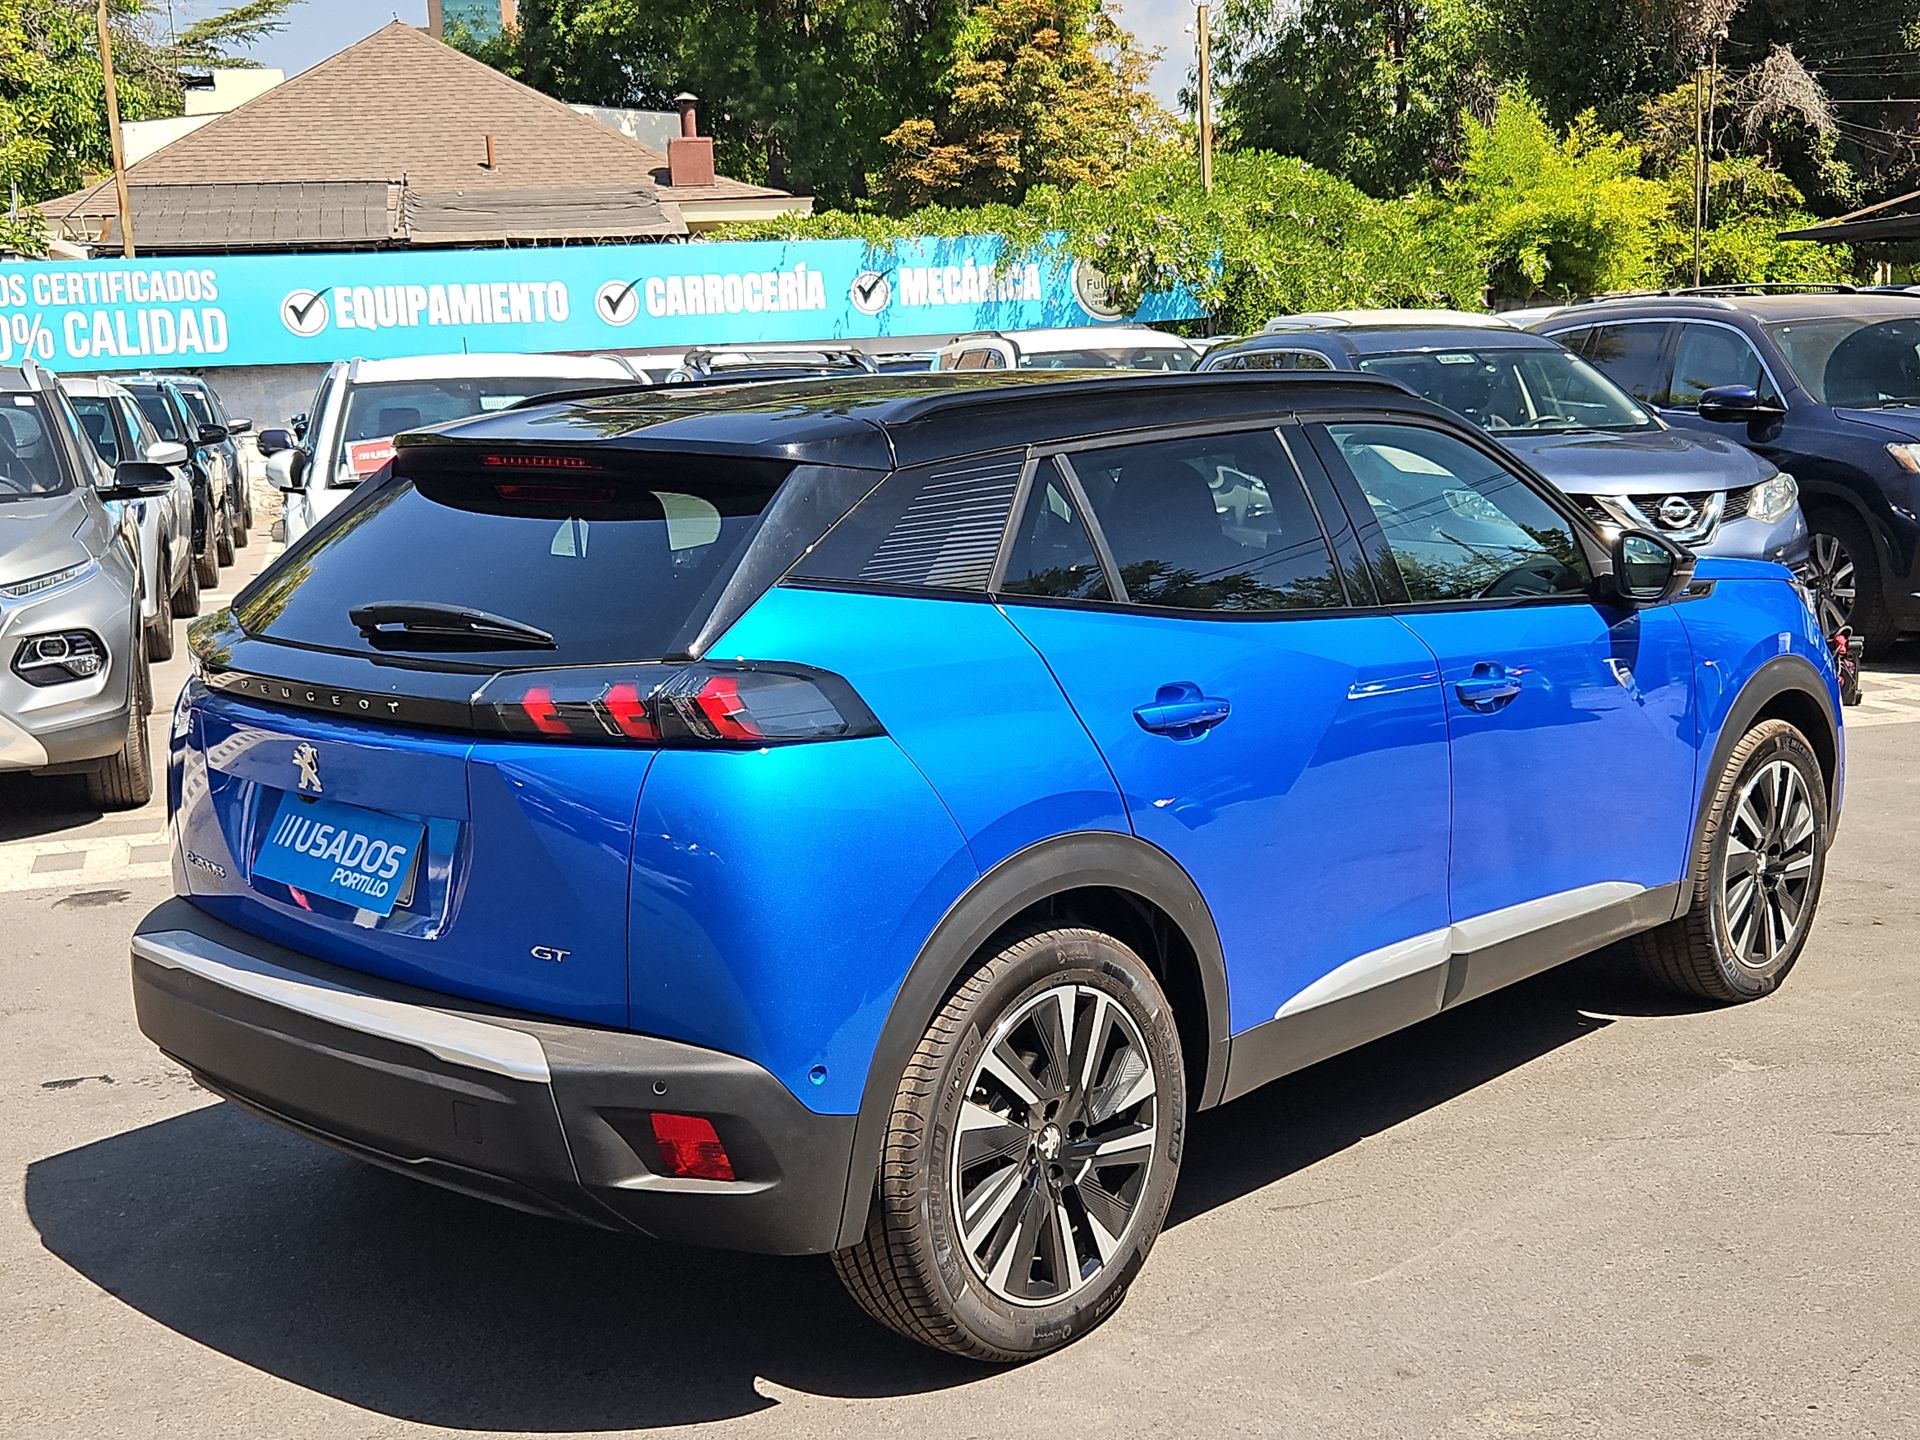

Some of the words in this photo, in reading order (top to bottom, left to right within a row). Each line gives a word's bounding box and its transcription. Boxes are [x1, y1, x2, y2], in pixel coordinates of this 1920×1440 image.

[31, 269, 218, 307] CERTIFICADOS
[334, 281, 571, 331] EQUIPAMIENTO
[645, 263, 826, 317] CARROCERÍA
[63, 307, 229, 360] CALIDAD
[240, 679, 400, 714] PEUGEOT
[298, 817, 407, 879] USADOS
[329, 866, 389, 898] PORTILLO
[529, 945, 572, 963] GT
